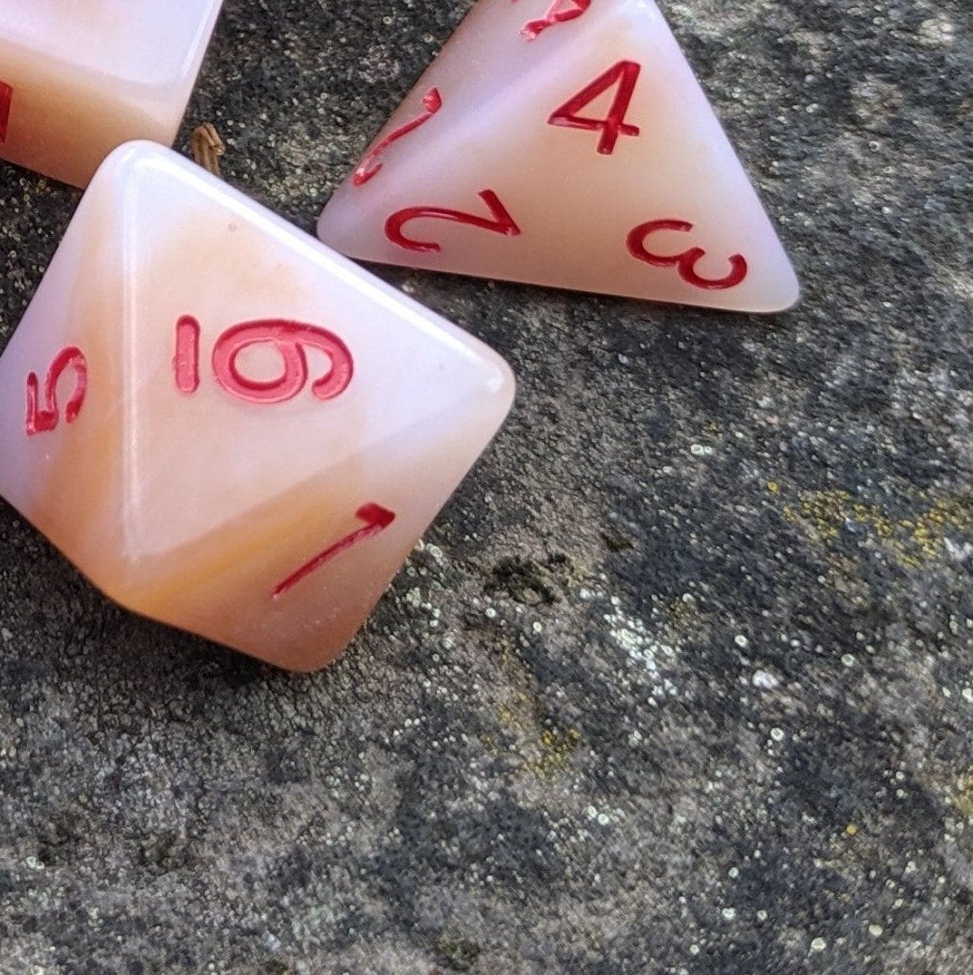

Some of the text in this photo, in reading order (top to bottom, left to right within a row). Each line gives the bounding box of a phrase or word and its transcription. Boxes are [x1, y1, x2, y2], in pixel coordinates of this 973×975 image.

[548, 60, 641, 155] 4
[384, 189, 522, 260] 2
[626, 218, 748, 291] 3
[25, 345, 89, 436] 5
[272, 502, 396, 599] 1
